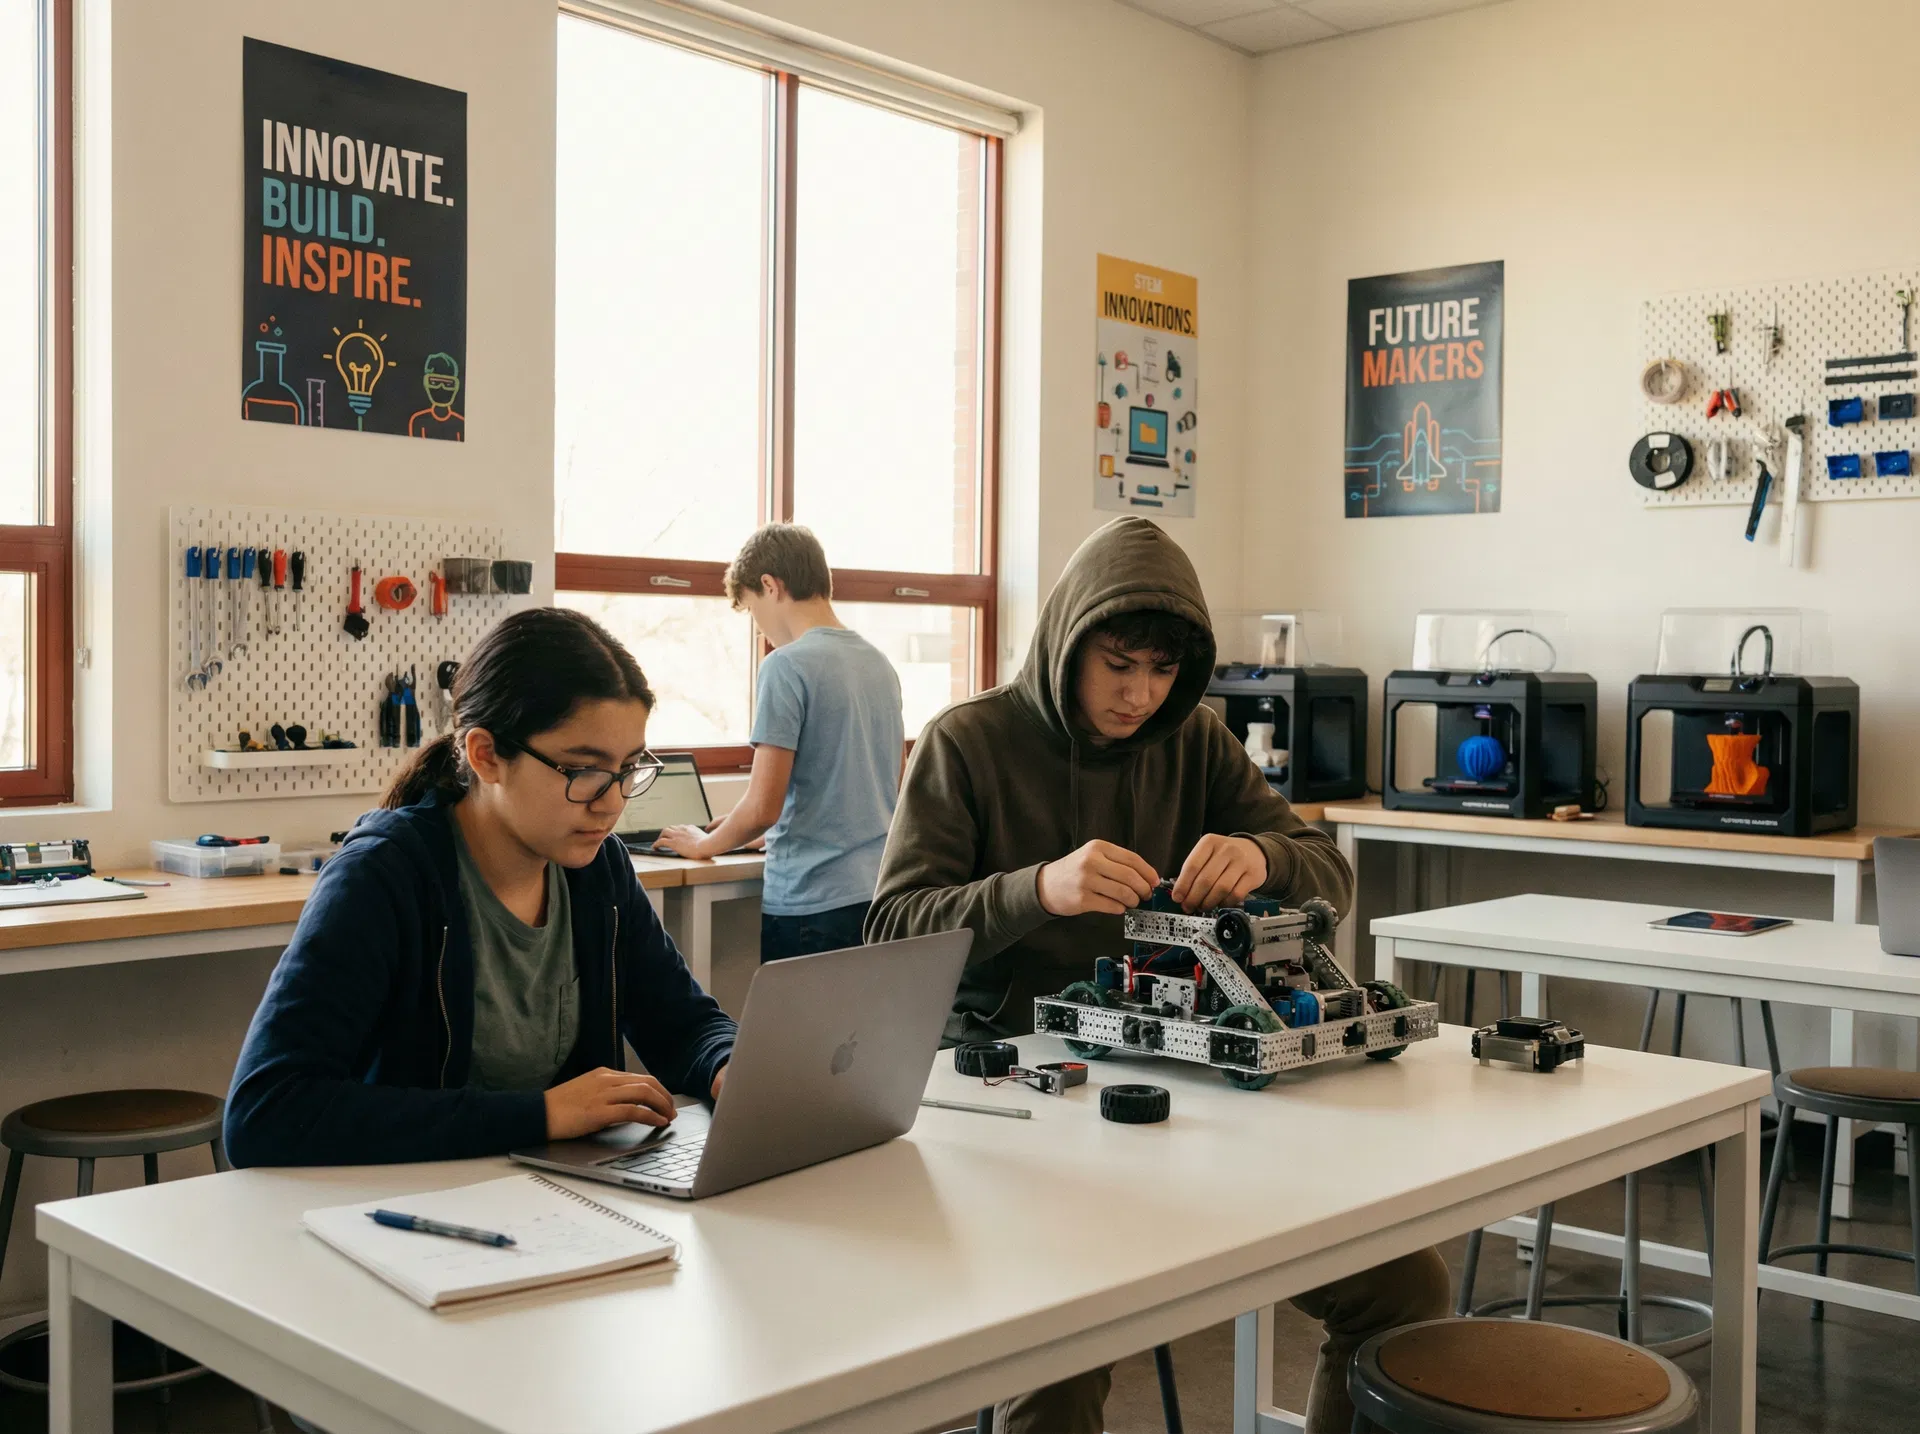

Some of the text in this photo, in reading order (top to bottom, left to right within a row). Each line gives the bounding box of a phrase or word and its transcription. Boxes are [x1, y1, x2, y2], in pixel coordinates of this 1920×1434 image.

[263, 118, 454, 207] INNOVATE.
[263, 176, 385, 247] BUILD.
[263, 234, 422, 308] INSPIRE.
[1104, 290, 1195, 335] INNOVATIONS.
[1368, 297, 1480, 346] FUTURE
[1363, 339, 1485, 388] MAKERS
